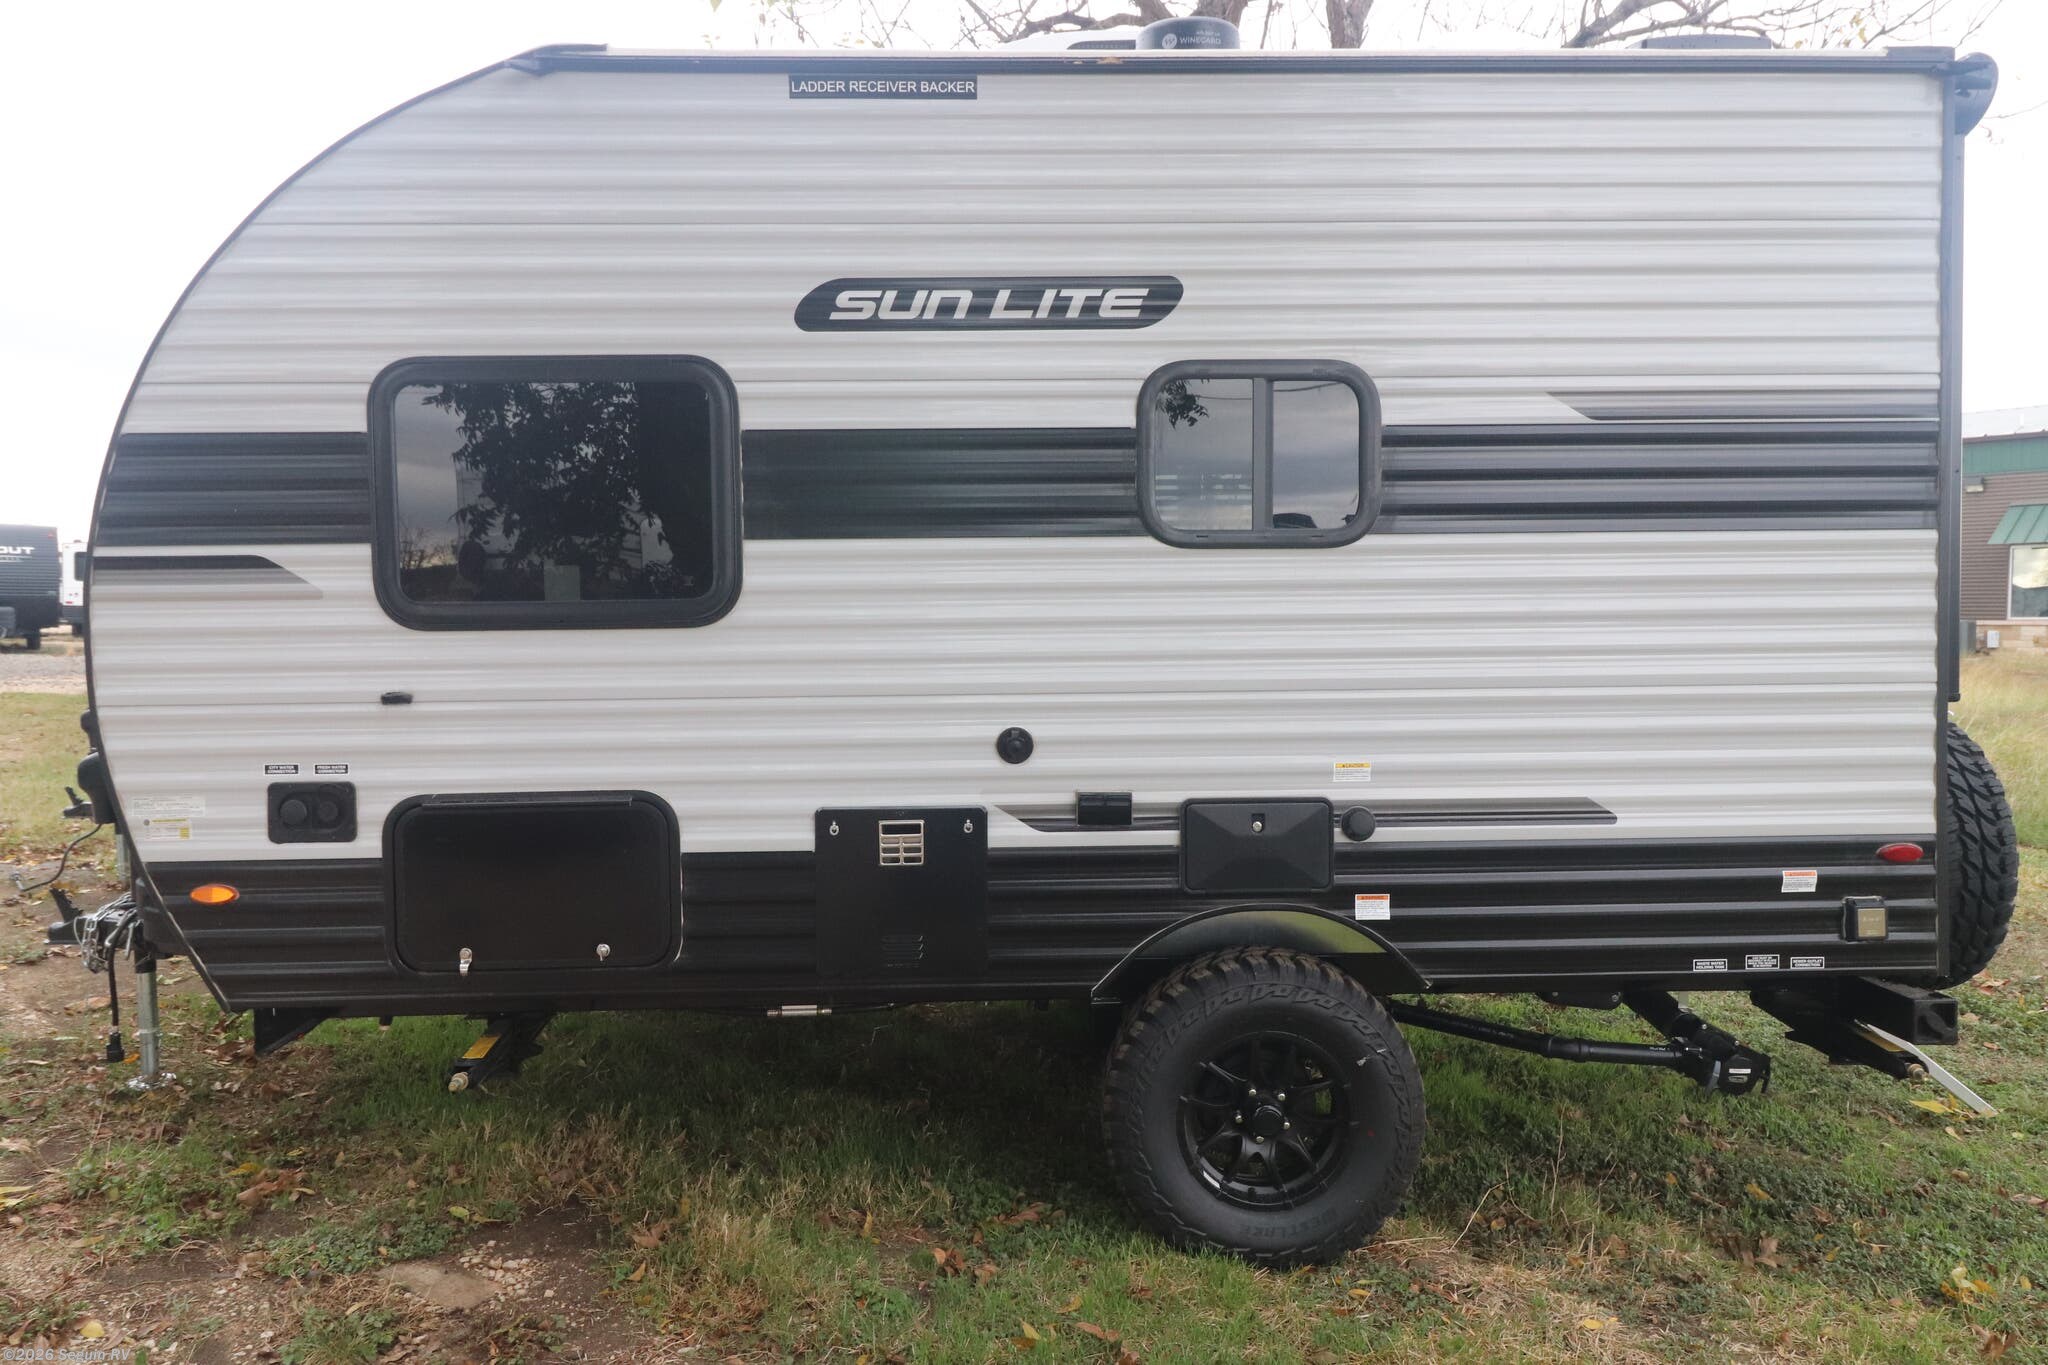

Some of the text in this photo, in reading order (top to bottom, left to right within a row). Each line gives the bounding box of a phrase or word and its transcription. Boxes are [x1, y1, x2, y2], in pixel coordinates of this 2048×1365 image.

[791, 81, 975, 93] LADDER RECEIVER BACKER
[828, 288, 1149, 320] SUN LITE
